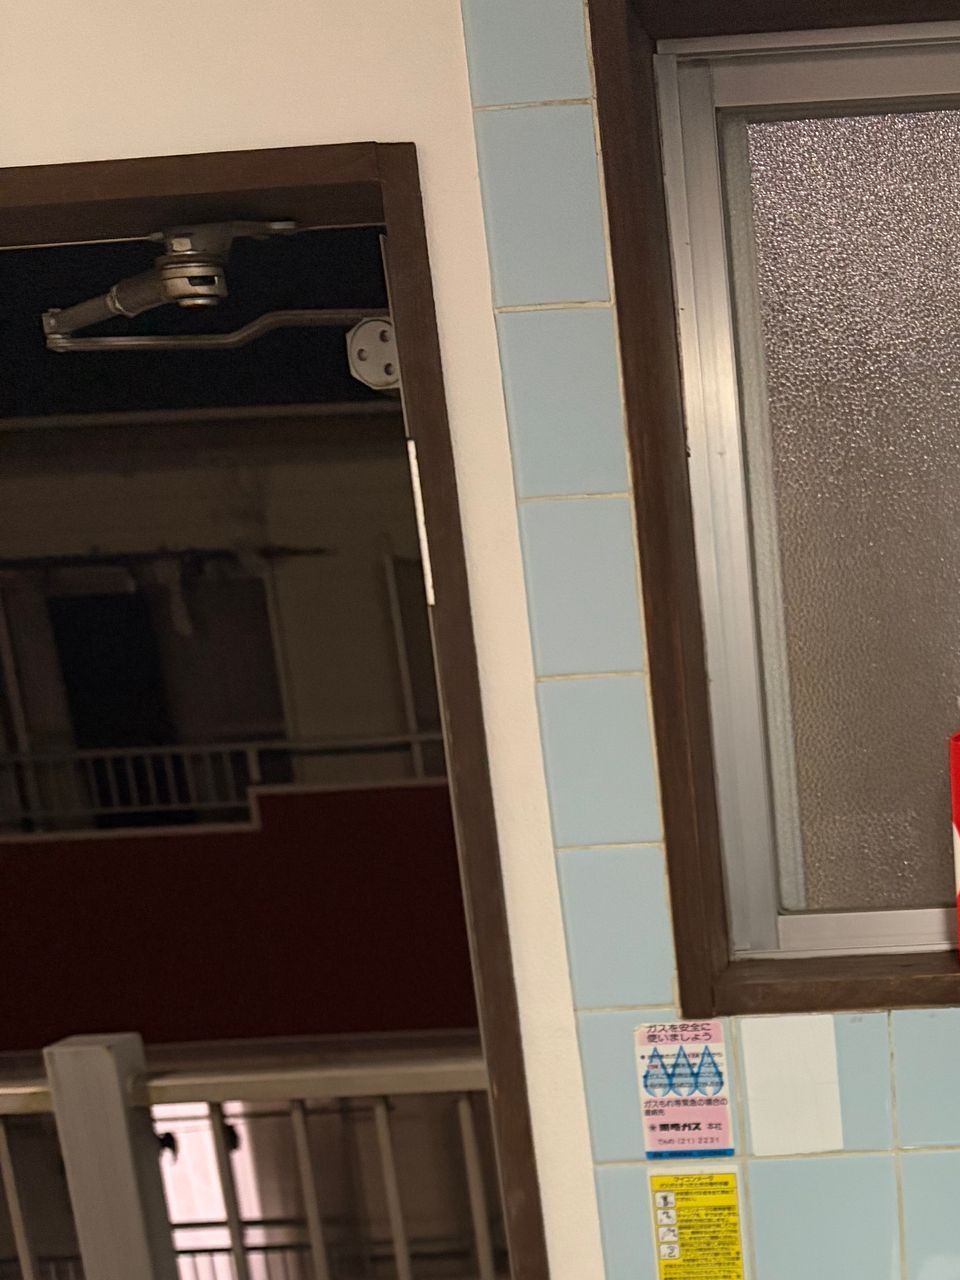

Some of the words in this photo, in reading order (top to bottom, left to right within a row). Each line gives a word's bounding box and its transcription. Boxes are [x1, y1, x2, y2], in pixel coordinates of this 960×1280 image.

[647, 1023, 711, 1033] ガスを安全に
[647, 1032, 712, 1043] 使いましょう
